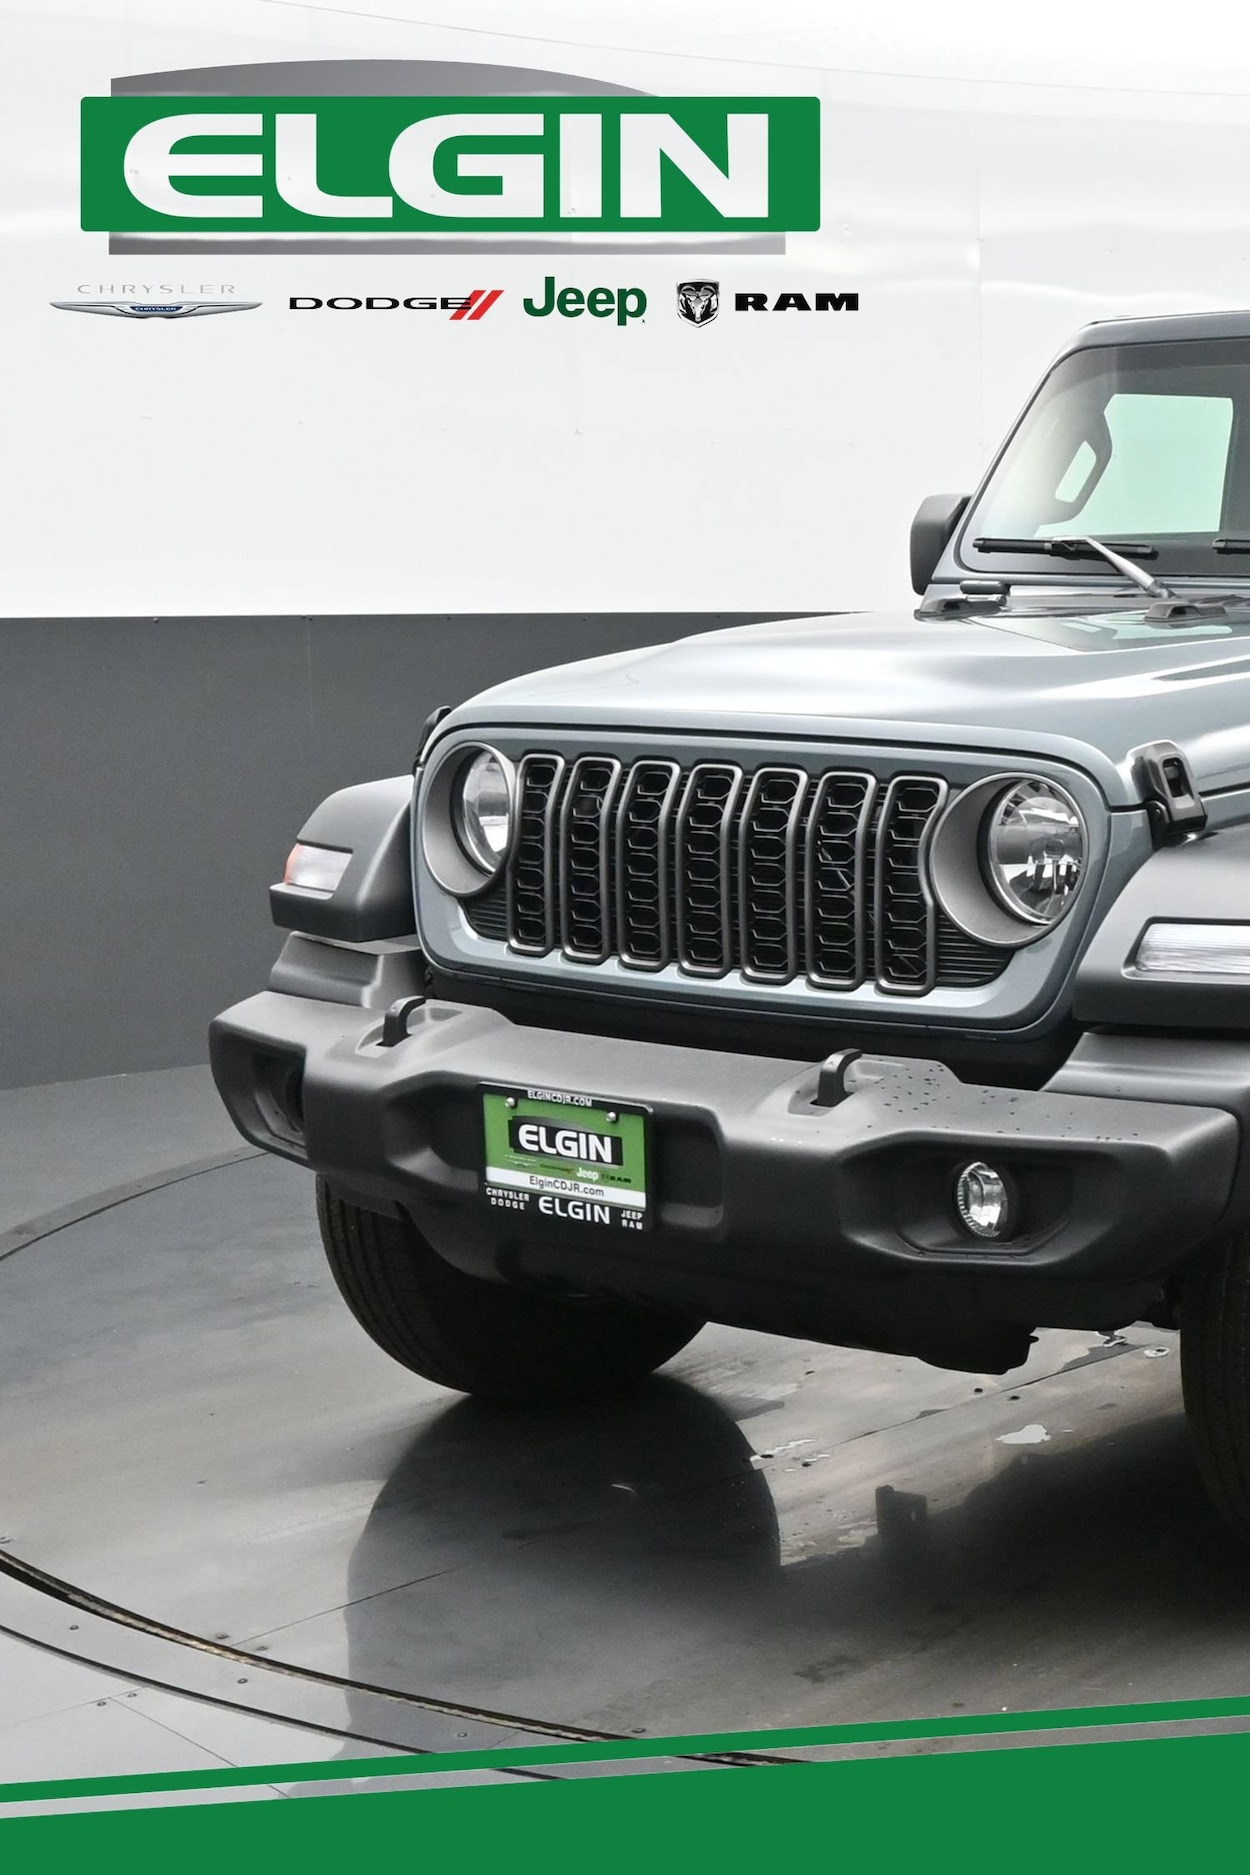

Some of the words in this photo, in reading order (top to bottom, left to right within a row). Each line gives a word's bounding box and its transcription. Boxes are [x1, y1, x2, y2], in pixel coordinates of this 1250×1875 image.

[527, 1089, 593, 1107] ELGINCDJR.COM
[518, 1123, 613, 1164] ELGIN
[576, 1167, 599, 1182] Jeep
[529, 1175, 605, 1197] ElginCDJR.com
[485, 1187, 530, 1202] CHRYSLER
[490, 1197, 526, 1211] DODGE
[538, 1195, 611, 1225] ELGIN
[620, 1209, 643, 1221] JEEP
[621, 1218, 643, 1231] RAM
